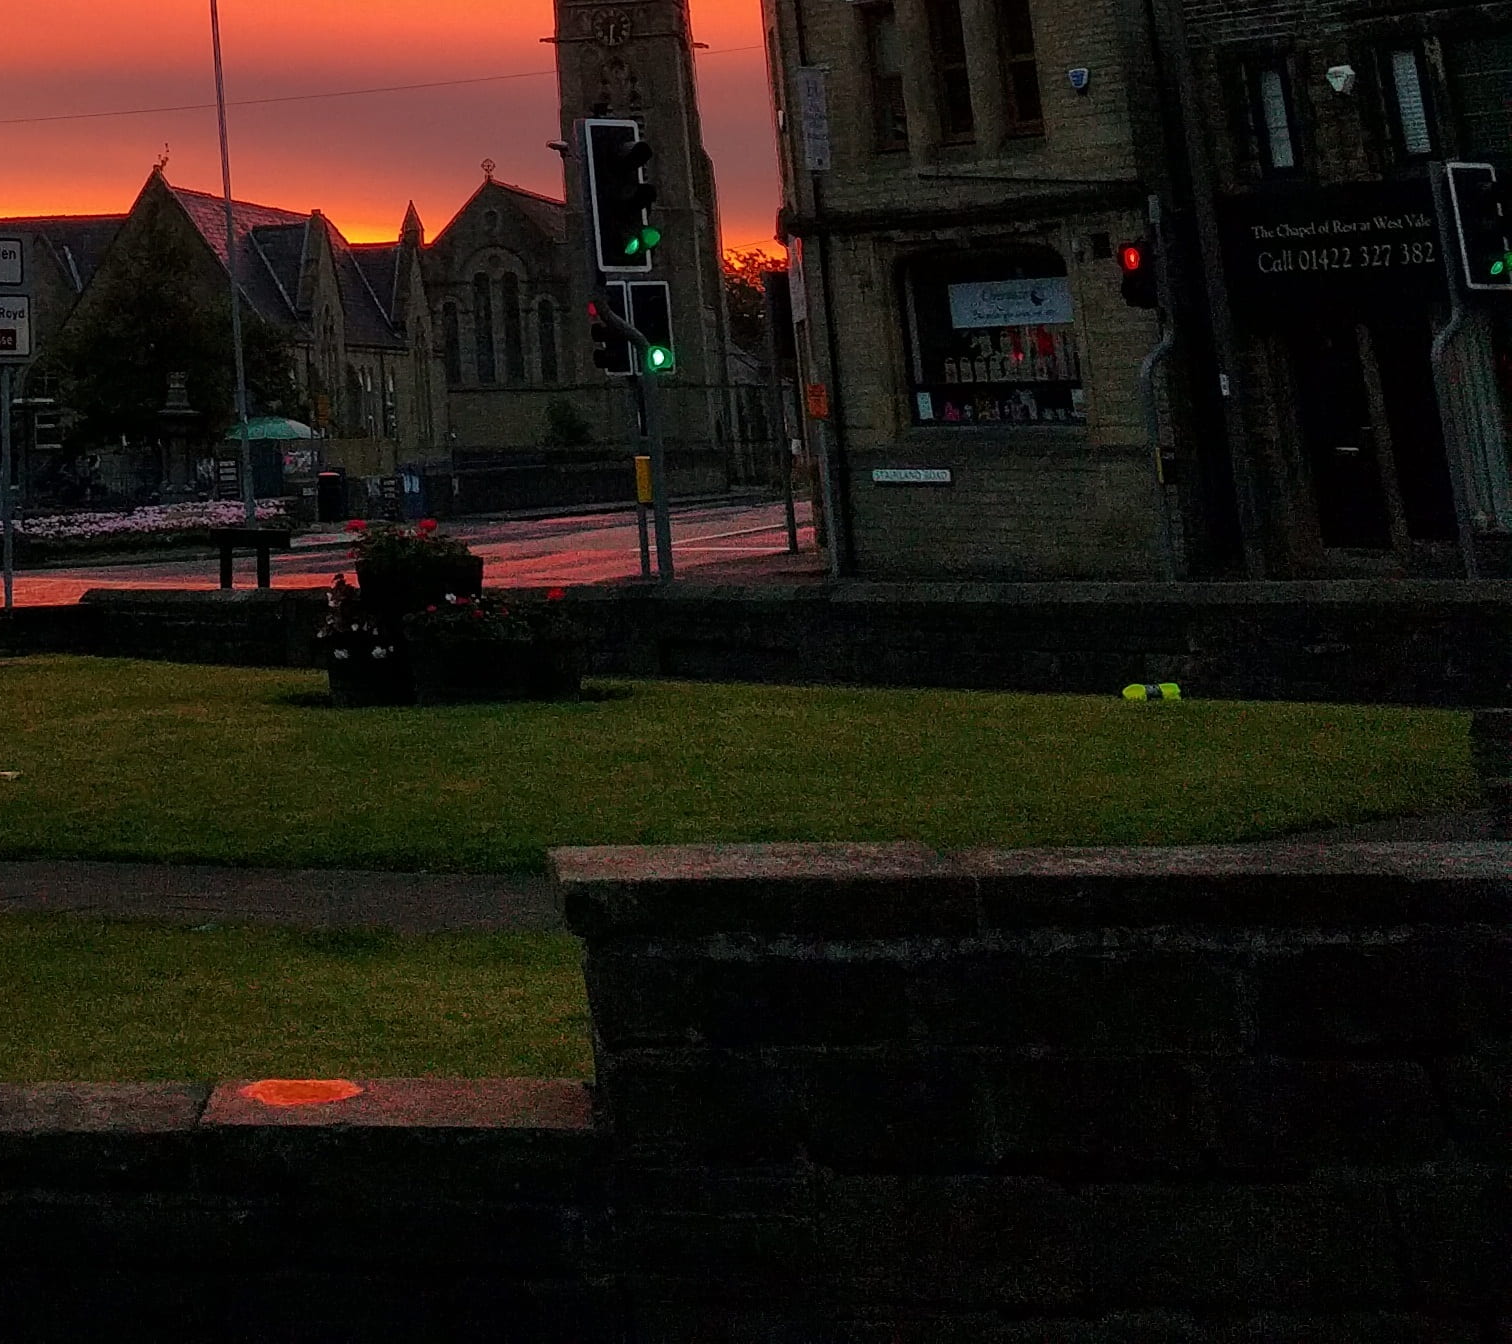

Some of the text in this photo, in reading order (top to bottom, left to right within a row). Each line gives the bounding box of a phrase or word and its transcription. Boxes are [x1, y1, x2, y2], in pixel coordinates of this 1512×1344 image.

[1252, 224, 1275, 239] The
[1276, 221, 1316, 238] Chapel
[1318, 220, 1331, 234] of
[1372, 216, 1403, 231] West
[1405, 212, 1432, 228] Vale
[1257, 241, 1436, 273] Call 01422 327 382
